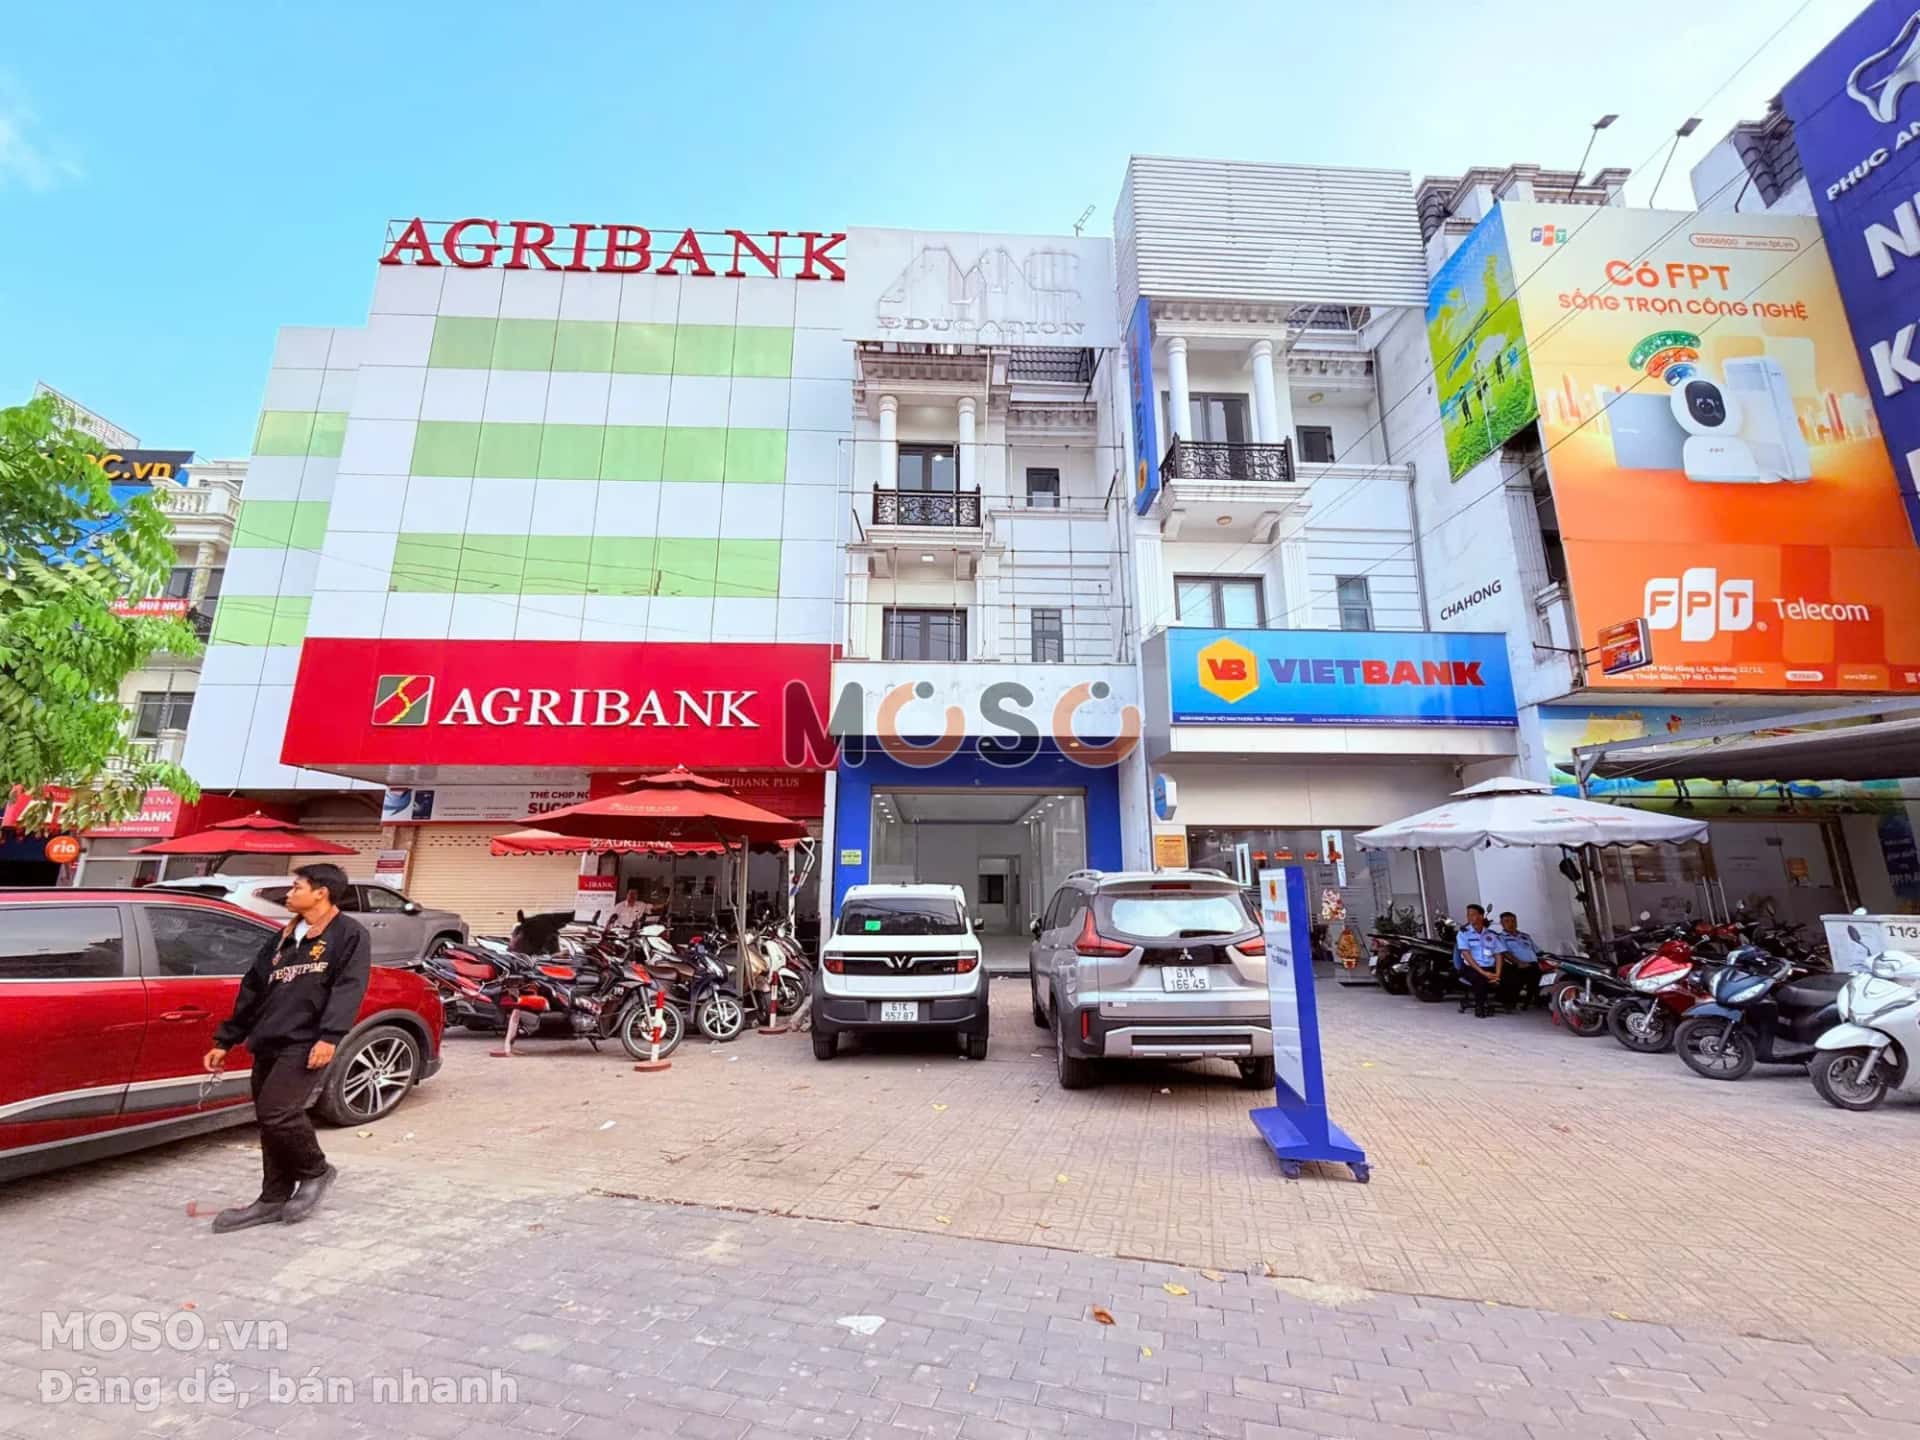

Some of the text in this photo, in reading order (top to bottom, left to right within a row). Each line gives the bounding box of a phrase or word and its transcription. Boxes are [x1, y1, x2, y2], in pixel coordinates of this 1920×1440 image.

[379, 217, 847, 281] AGRIBANK
[1665, 262, 1730, 290] FPT
[876, 316, 1086, 337] EDUCATION
[1440, 579, 1502, 621] CHAHONG
[1648, 580, 1870, 628] FPT Telecom
[1207, 658, 1486, 686] VB VIETBANK
[438, 687, 760, 728] AGRIBANK
[551, 791, 575, 799] CHIP
[773, 776, 800, 787] PLUS
